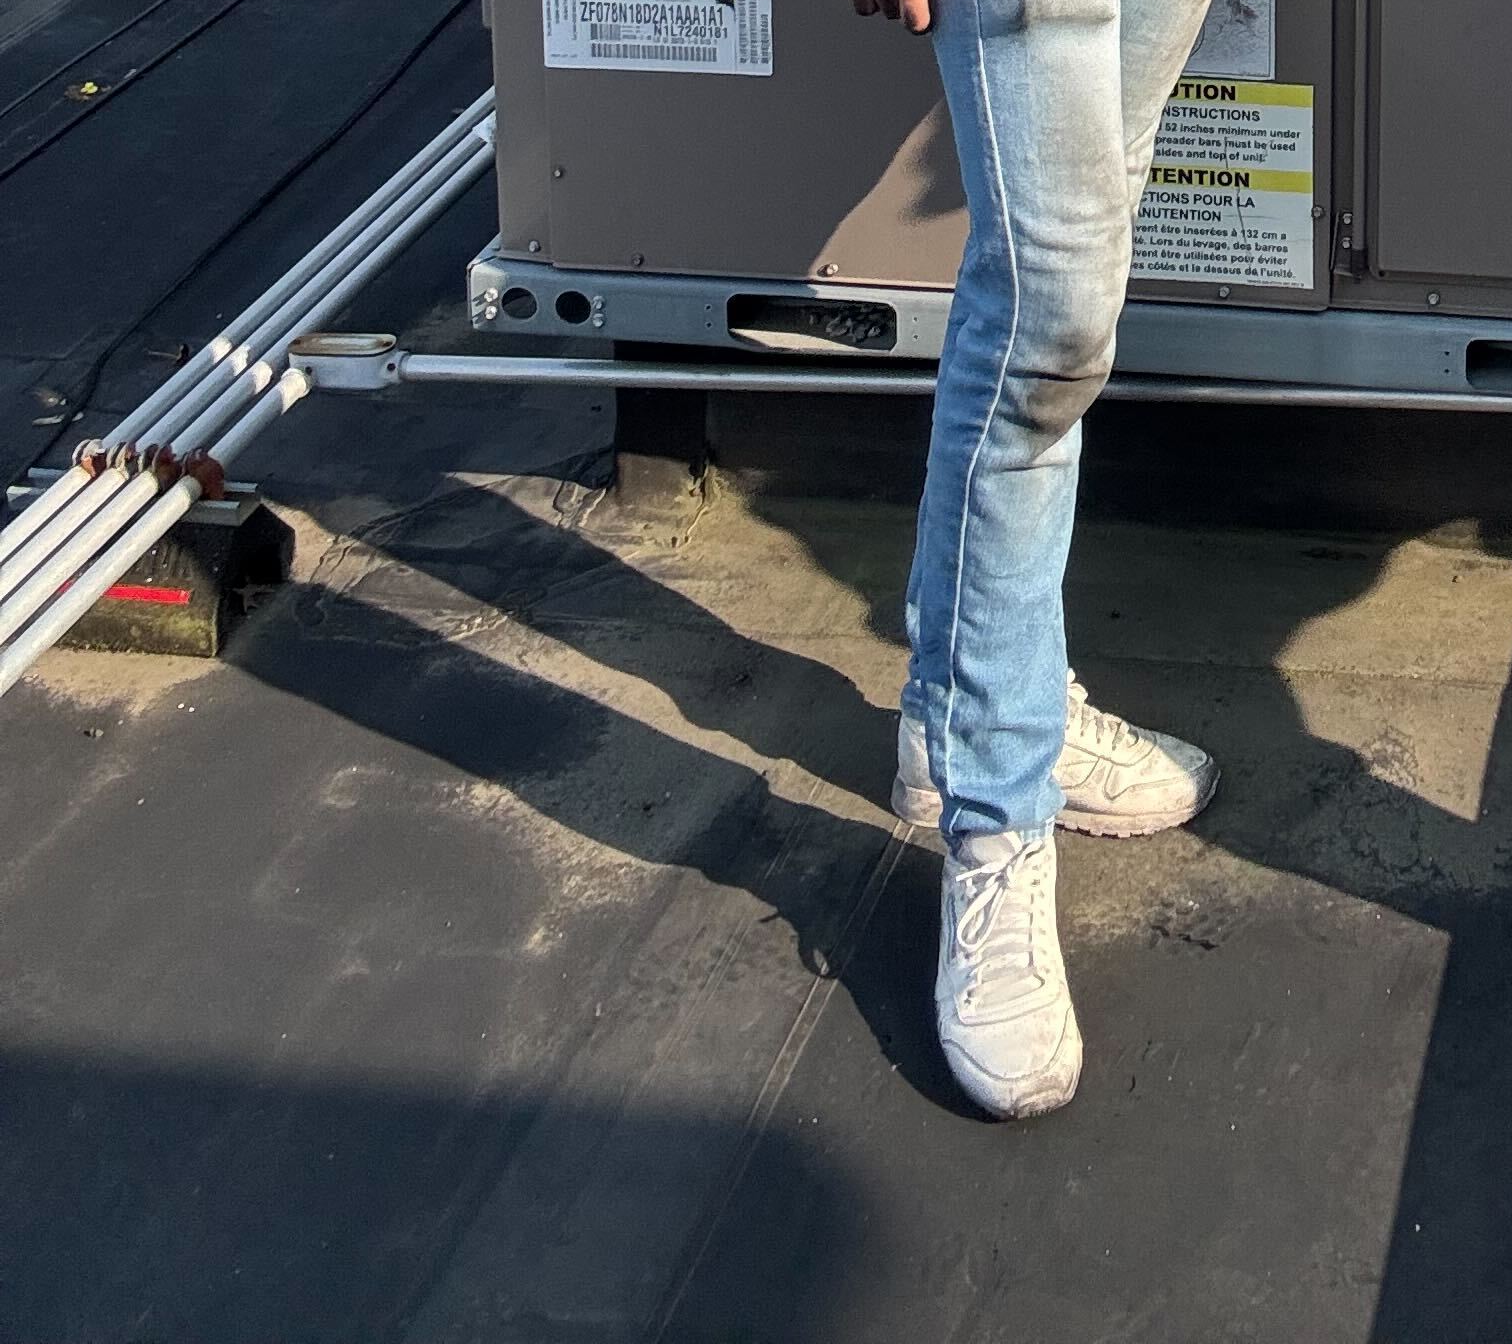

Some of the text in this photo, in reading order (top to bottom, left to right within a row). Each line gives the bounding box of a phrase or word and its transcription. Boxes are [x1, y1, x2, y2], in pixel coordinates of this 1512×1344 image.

[1169, 82, 1236, 101] UTION
[1162, 105, 1261, 122] NSTRUCTIONS
[1165, 122, 1178, 132] 52
[1180, 123, 1215, 135] inches
[1217, 126, 1267, 137] minimum
[1269, 129, 1301, 139] under
[1155, 136, 1296, 152] preader bars must be used
[1185, 150, 1206, 159] and
[1208, 150, 1226, 162] top
[1228, 152, 1240, 161] of
[1150, 168, 1250, 188] TENTION
[1193, 194, 1233, 208] POUR
[1237, 197, 1256, 209] LA
[1137, 207, 1222, 222] NUTENTION
[1135, 223, 1159, 233] vent
[1261, 231, 1278, 240] cm
[1149, 235, 1174, 246] Lors
[1176, 237, 1191, 248] du
[1230, 254, 1255, 264] pour
[1257, 253, 1289, 266] éviter
